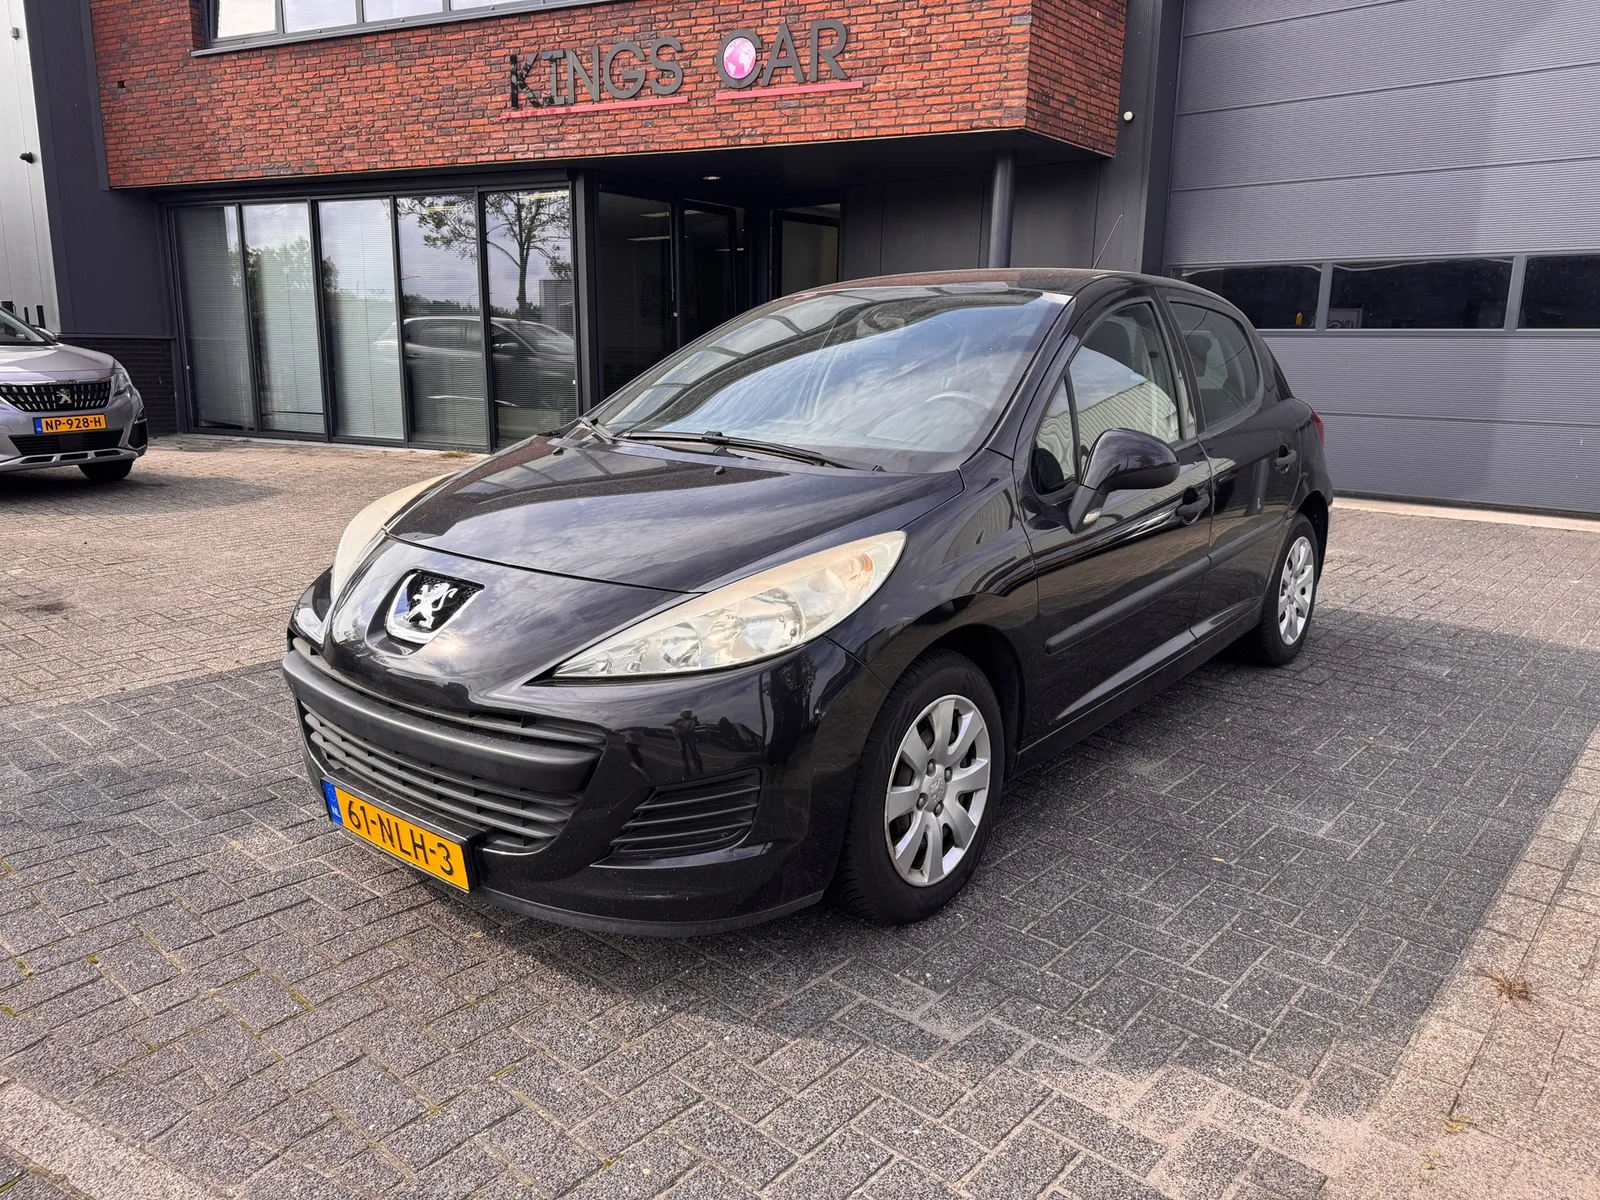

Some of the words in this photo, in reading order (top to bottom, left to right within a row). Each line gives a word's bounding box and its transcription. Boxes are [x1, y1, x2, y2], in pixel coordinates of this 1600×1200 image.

[510, 36, 684, 109] KINGS
[716, 18, 848, 89] CAR
[45, 416, 102, 431] NP-928-H
[331, 804, 341, 818] NL
[347, 799, 454, 876] 61-NLH-3
